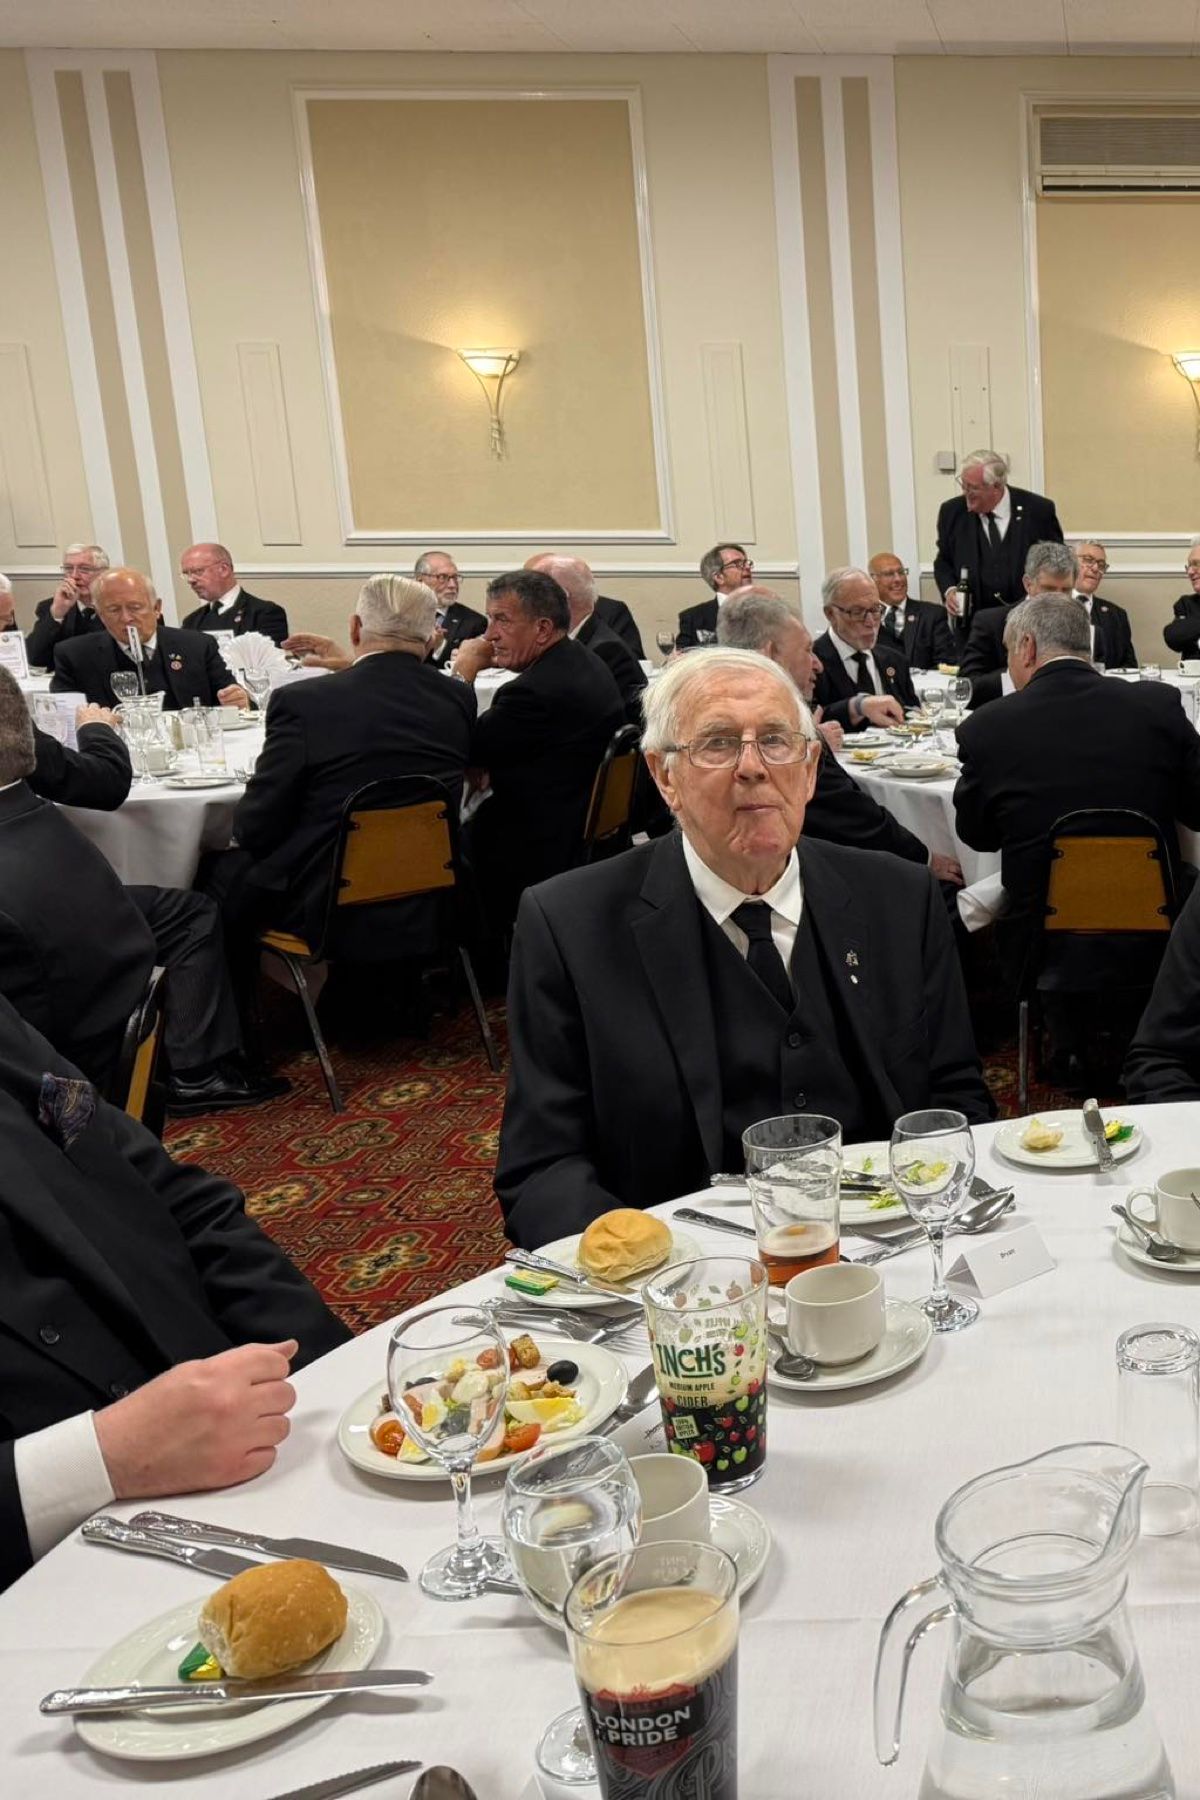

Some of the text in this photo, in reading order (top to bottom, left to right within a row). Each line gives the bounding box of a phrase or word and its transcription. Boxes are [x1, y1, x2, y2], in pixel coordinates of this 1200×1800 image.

[656, 1343, 726, 1379] INCH'S
[668, 1381, 715, 1391] MEDIUM APPLE
[676, 1396, 709, 1408] CIDER
[590, 1705, 691, 1732] LONDON
[607, 1725, 678, 1746] PRIDE
